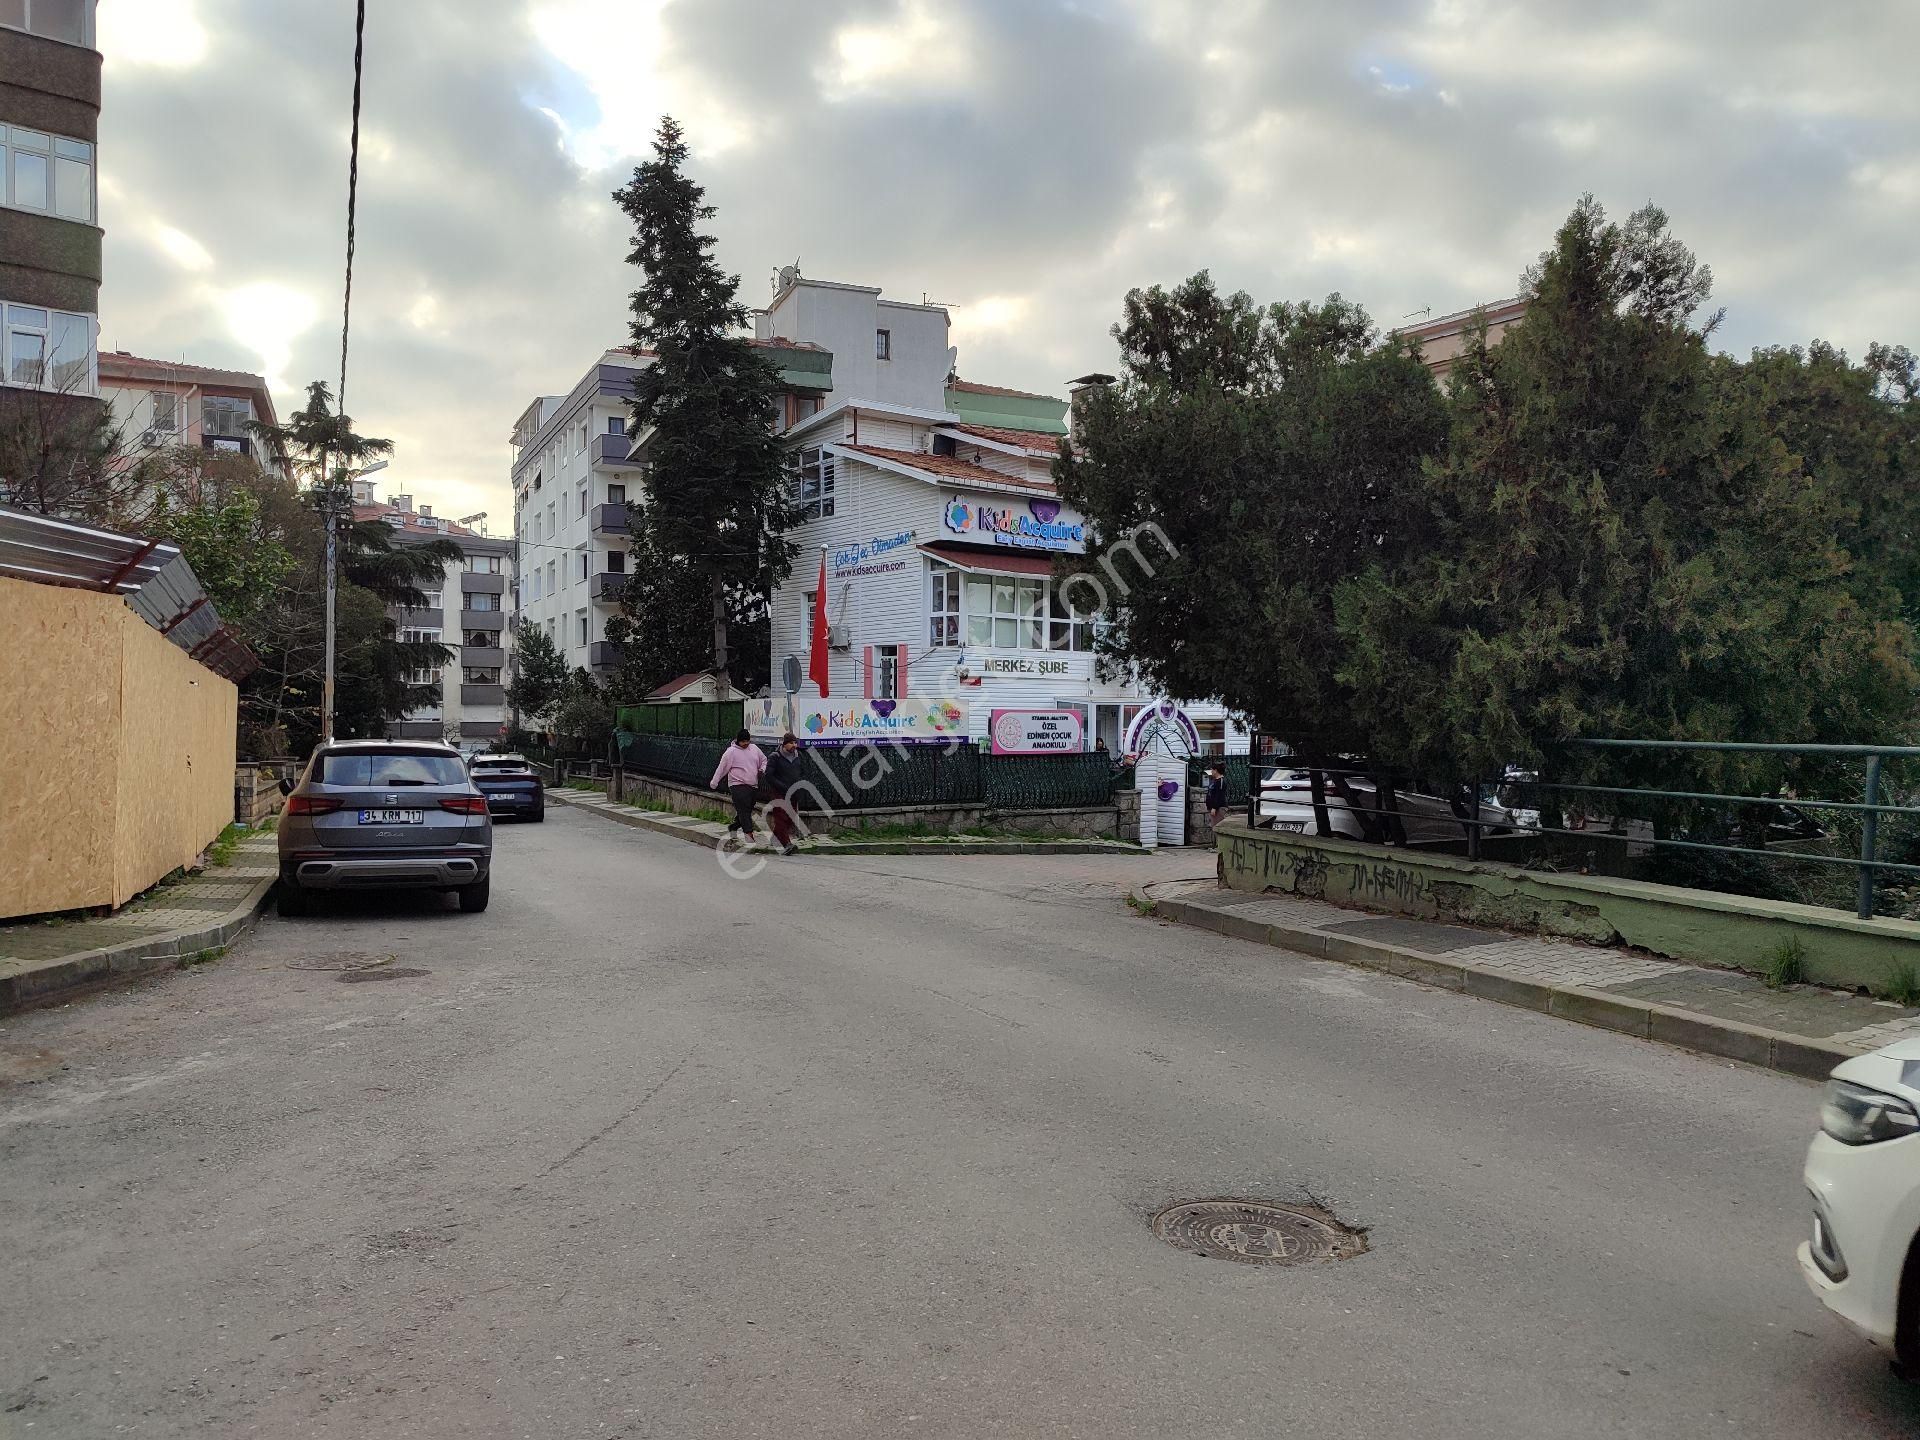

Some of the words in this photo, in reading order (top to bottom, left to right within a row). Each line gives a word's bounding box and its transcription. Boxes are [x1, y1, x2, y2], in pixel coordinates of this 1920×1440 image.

[978, 506, 1082, 541] KidsAcquire
[984, 659, 1035, 673] MERKEZ
[1038, 661, 1069, 676] ŞUBE
[828, 708, 916, 730] KidsAcquire
[1042, 722, 1057, 731] ÖZEL
[1027, 731, 1050, 740] EDİNEN
[1051, 732, 1072, 741] ÇOCUK
[1032, 741, 1067, 749] ANAOKULU
[364, 810, 377, 820] 34
[405, 811, 421, 820] 717
